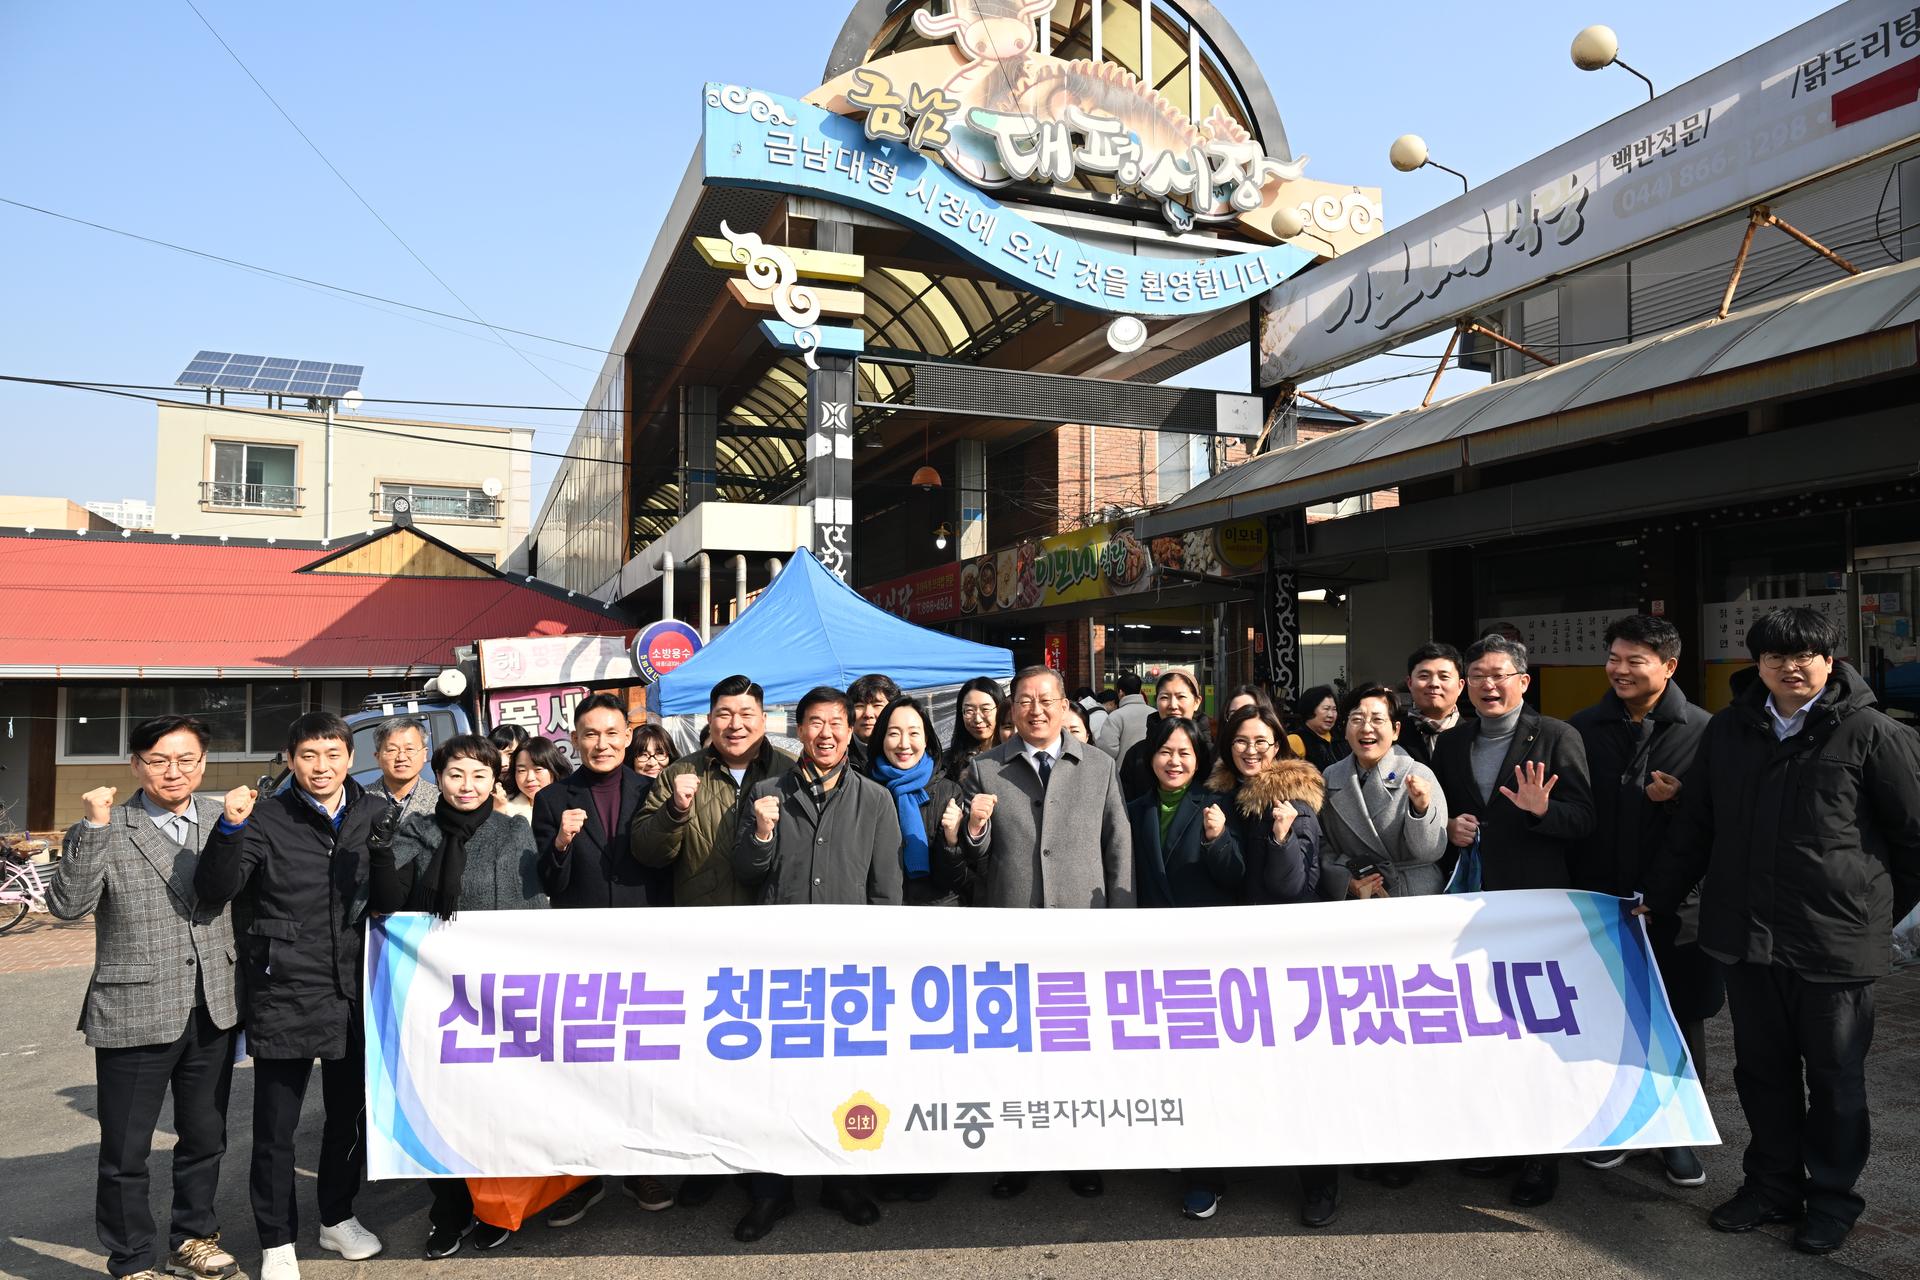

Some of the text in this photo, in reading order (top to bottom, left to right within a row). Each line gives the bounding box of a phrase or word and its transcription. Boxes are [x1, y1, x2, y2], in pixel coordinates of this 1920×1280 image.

[847, 67, 1311, 213] 금남 대평시장
[1679, 115, 1808, 187] 866-298
[765, 130, 1285, 302] 금남대평 시장에 오신 것을 환영합니다.
[1226, 527, 1263, 545] 이모네
[1034, 538, 1127, 595] 이모네 식당
[652, 648, 690, 659] 소방용수
[438, 960, 1580, 1064] 신뢰받는 청렴한 의회를 만들어 가겠습니다
[846, 1114, 875, 1130] 의회
[904, 1098, 1184, 1149] 세종 특별자치시의회
